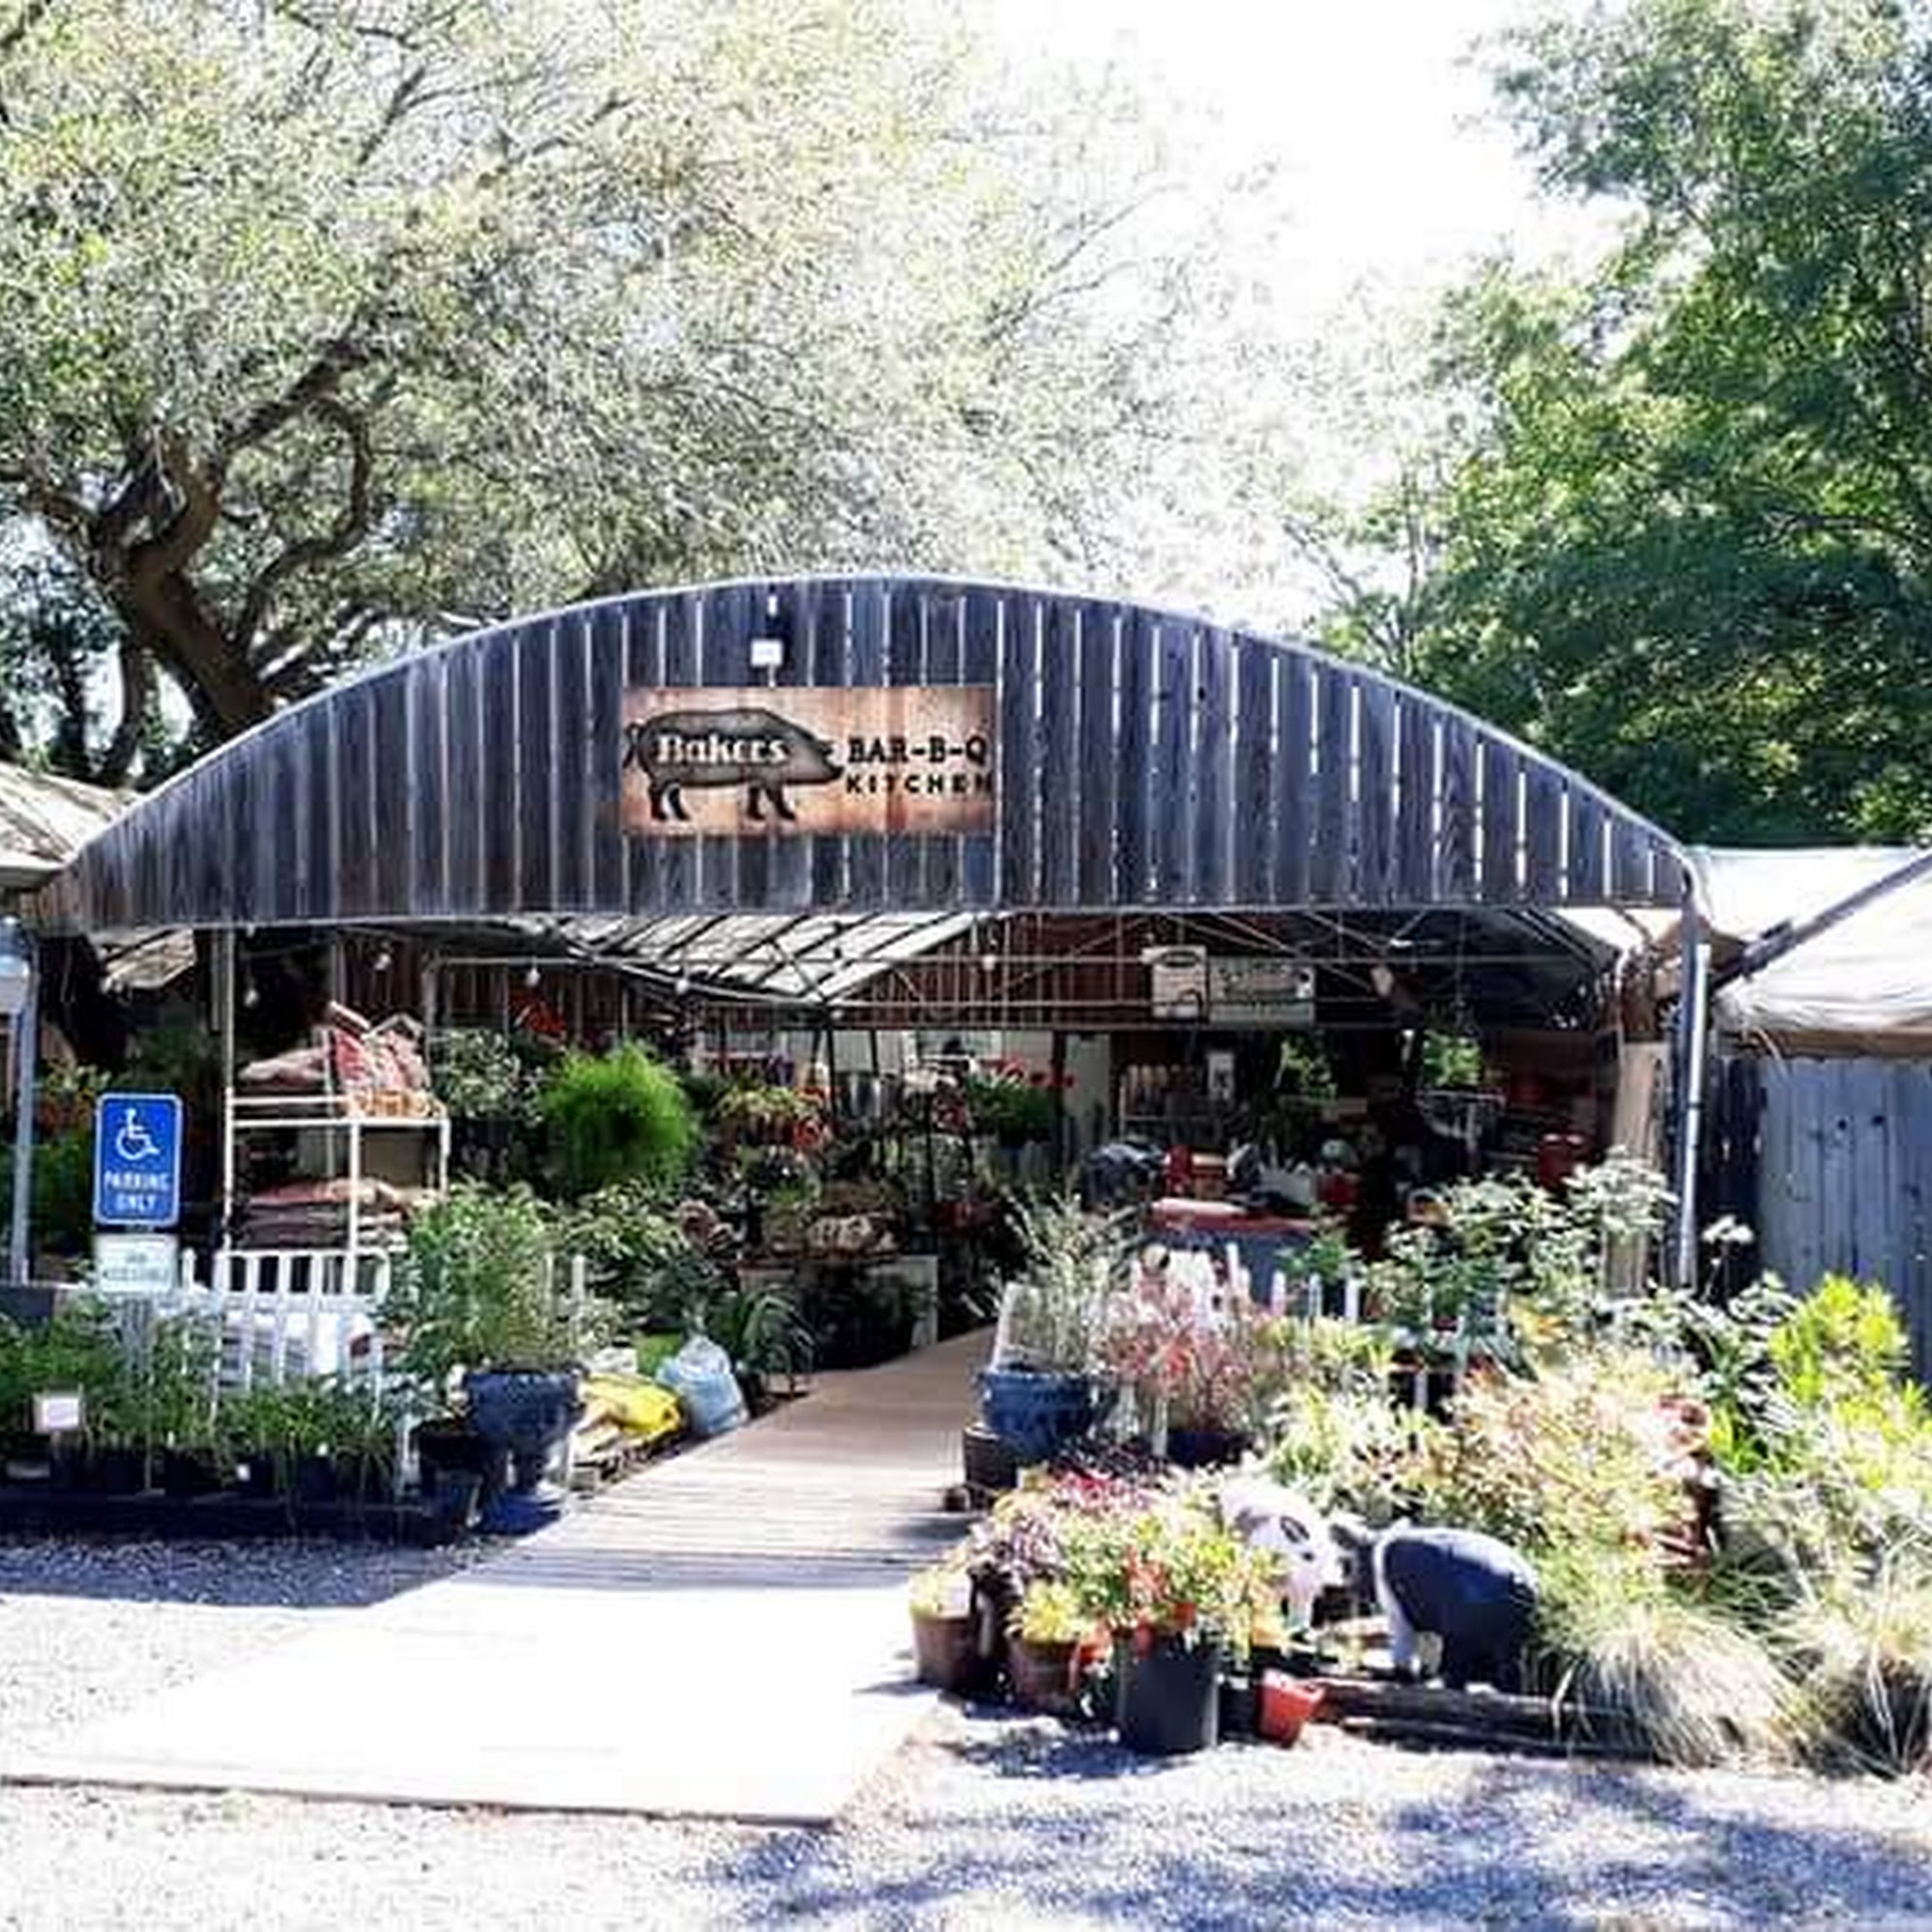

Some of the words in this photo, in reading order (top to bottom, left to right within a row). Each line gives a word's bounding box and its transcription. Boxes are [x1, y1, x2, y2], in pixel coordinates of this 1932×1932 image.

[847, 734, 987, 766] BAR-B-Q
[845, 774, 993, 794] KITCHEN
[104, 1171, 169, 1191] PARKING
[116, 1193, 156, 1212] ONLY
